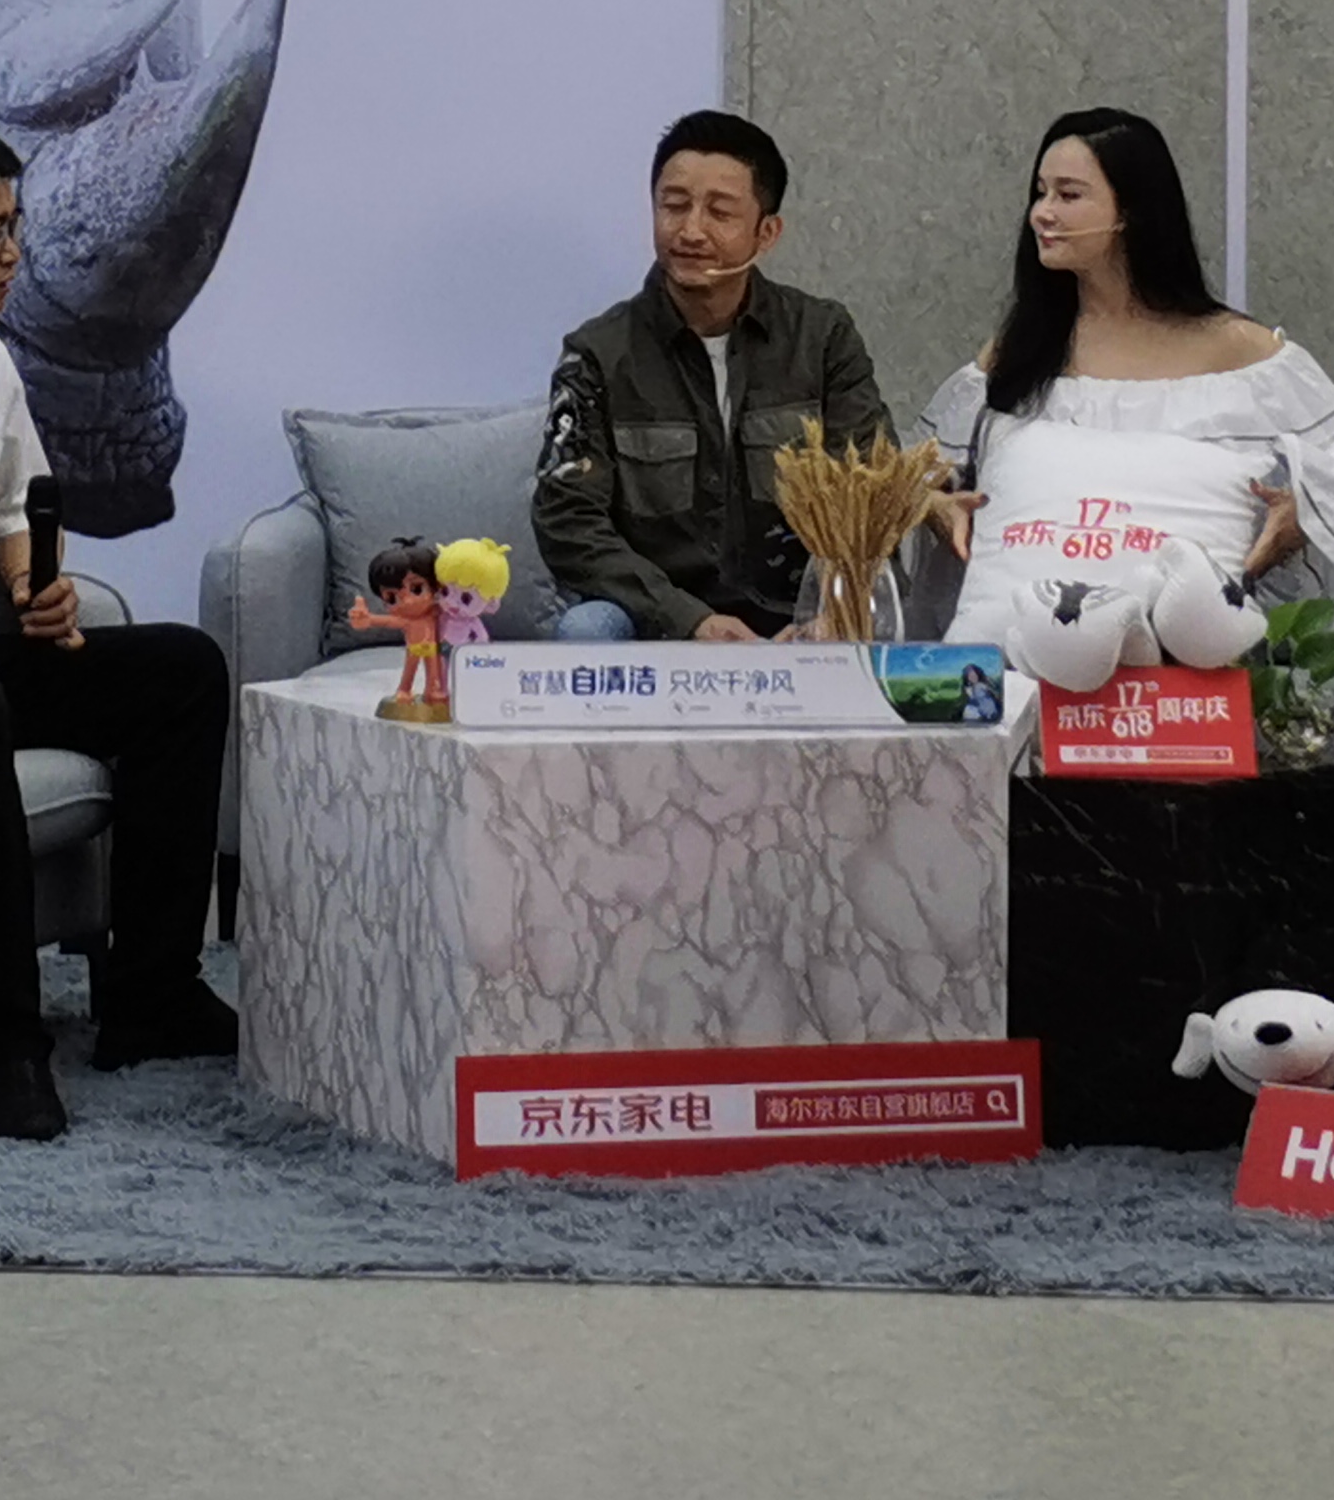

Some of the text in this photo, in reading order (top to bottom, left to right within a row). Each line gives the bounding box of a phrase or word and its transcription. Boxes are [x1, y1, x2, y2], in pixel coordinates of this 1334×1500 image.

[1062, 532, 1113, 560] 618
[465, 656, 506, 669] Haier
[669, 669, 795, 696] 只吹干净风
[1057, 696, 1231, 738] 京东 618 周年庆
[519, 1091, 714, 1138] 京东家电
